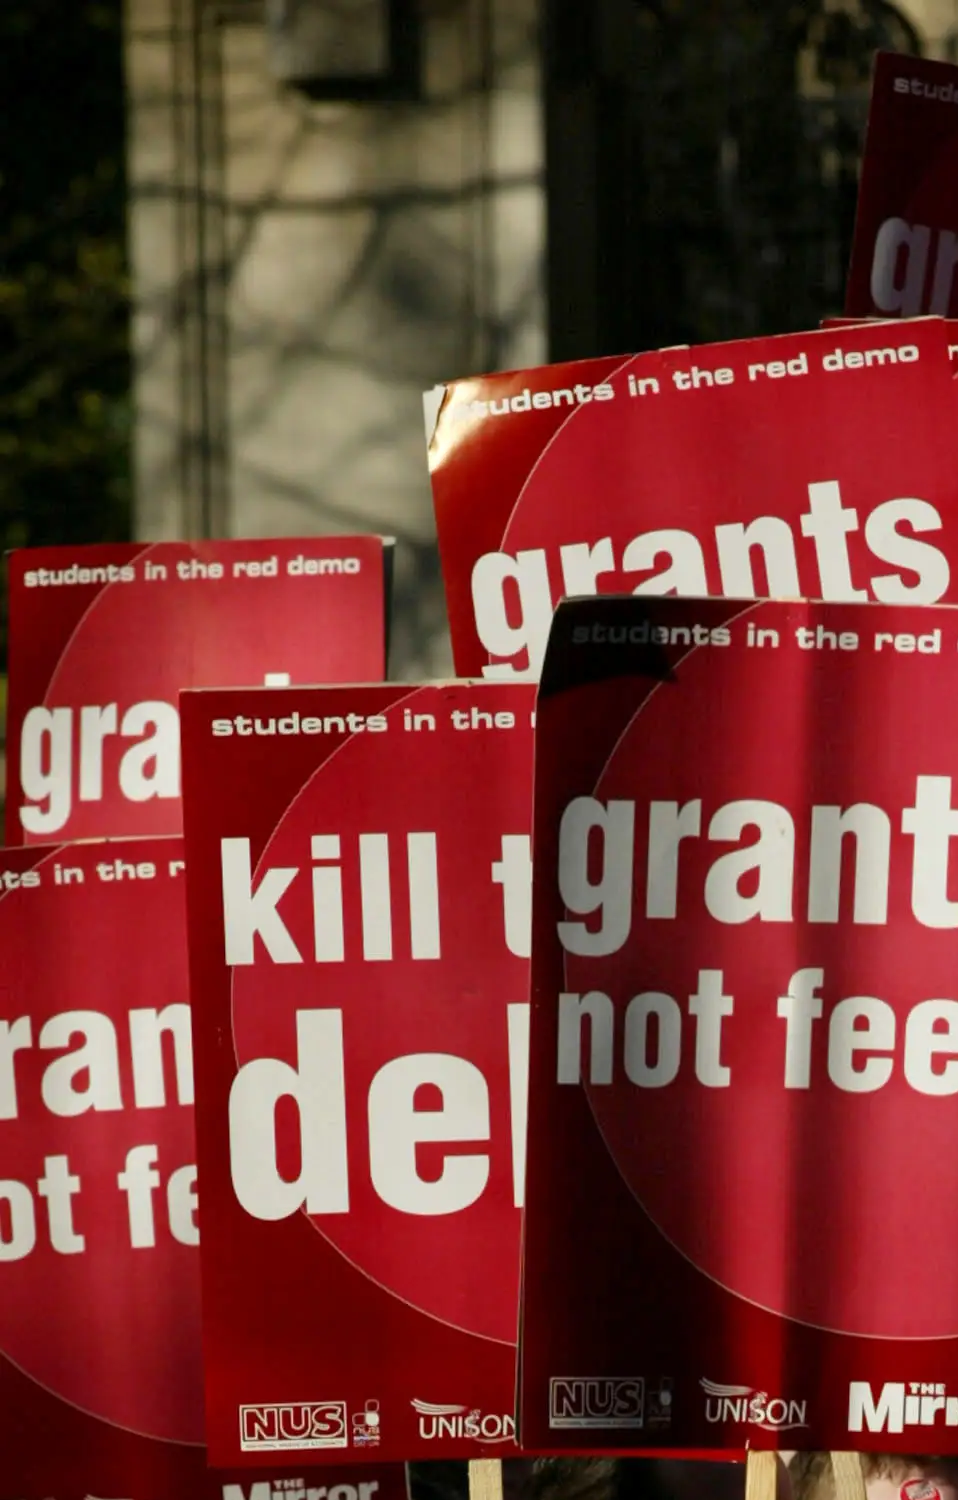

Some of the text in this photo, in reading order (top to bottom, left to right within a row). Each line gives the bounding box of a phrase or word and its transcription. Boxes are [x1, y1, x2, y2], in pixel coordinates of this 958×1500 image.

[628, 374, 660, 398] in
[673, 366, 734, 392] the
[748, 355, 809, 382] red
[823, 344, 919, 373] demo
[24, 554, 361, 588] students in the red demo
[471, 480, 951, 678] grants
[572, 623, 731, 647] students
[747, 623, 779, 648] in
[796, 624, 859, 651] the
[874, 628, 940, 655] red
[212, 711, 388, 737] students
[404, 708, 435, 731] in
[450, 707, 515, 730] the
[54, 858, 84, 884] in
[97, 859, 156, 882] the
[220, 832, 441, 966] kill
[557, 969, 734, 1088] not
[553, 1380, 641, 1418] NUS
[909, 1383, 945, 1396] THE
[243, 1404, 345, 1440] NUS
[705, 1393, 808, 1424] UNISON
[274, 1480, 304, 1491] THE
